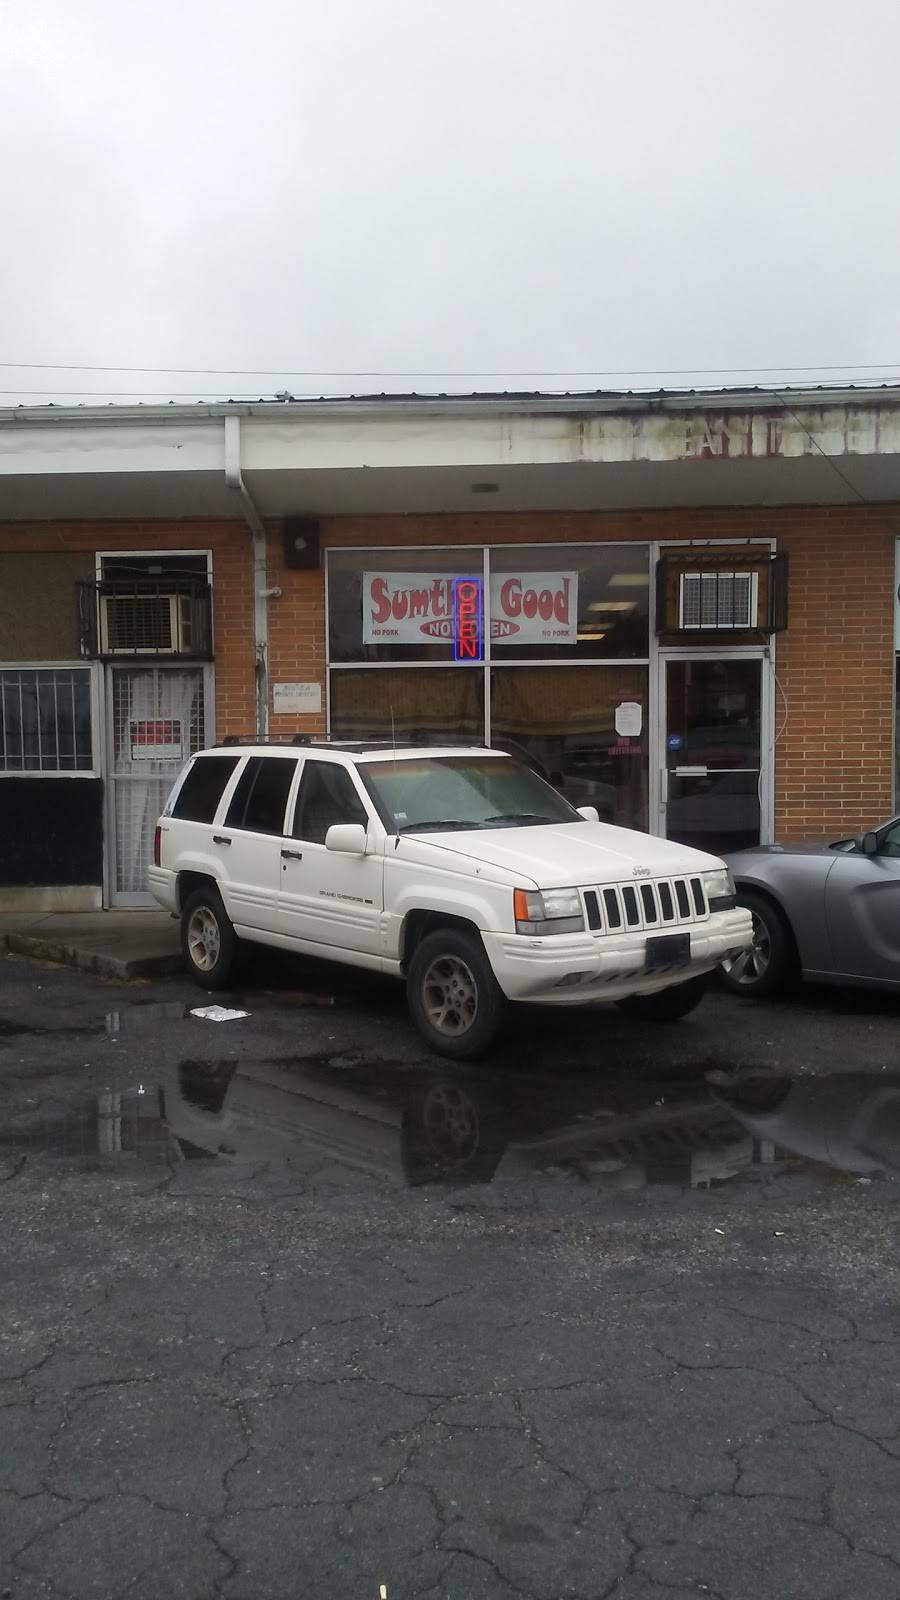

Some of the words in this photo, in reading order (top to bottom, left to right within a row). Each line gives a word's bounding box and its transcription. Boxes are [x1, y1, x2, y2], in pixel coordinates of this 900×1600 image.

[458, 582, 477, 657] OPEN
[501, 577, 570, 625] Good
[542, 629, 551, 637] NO
[552, 629, 570, 637] PORK
